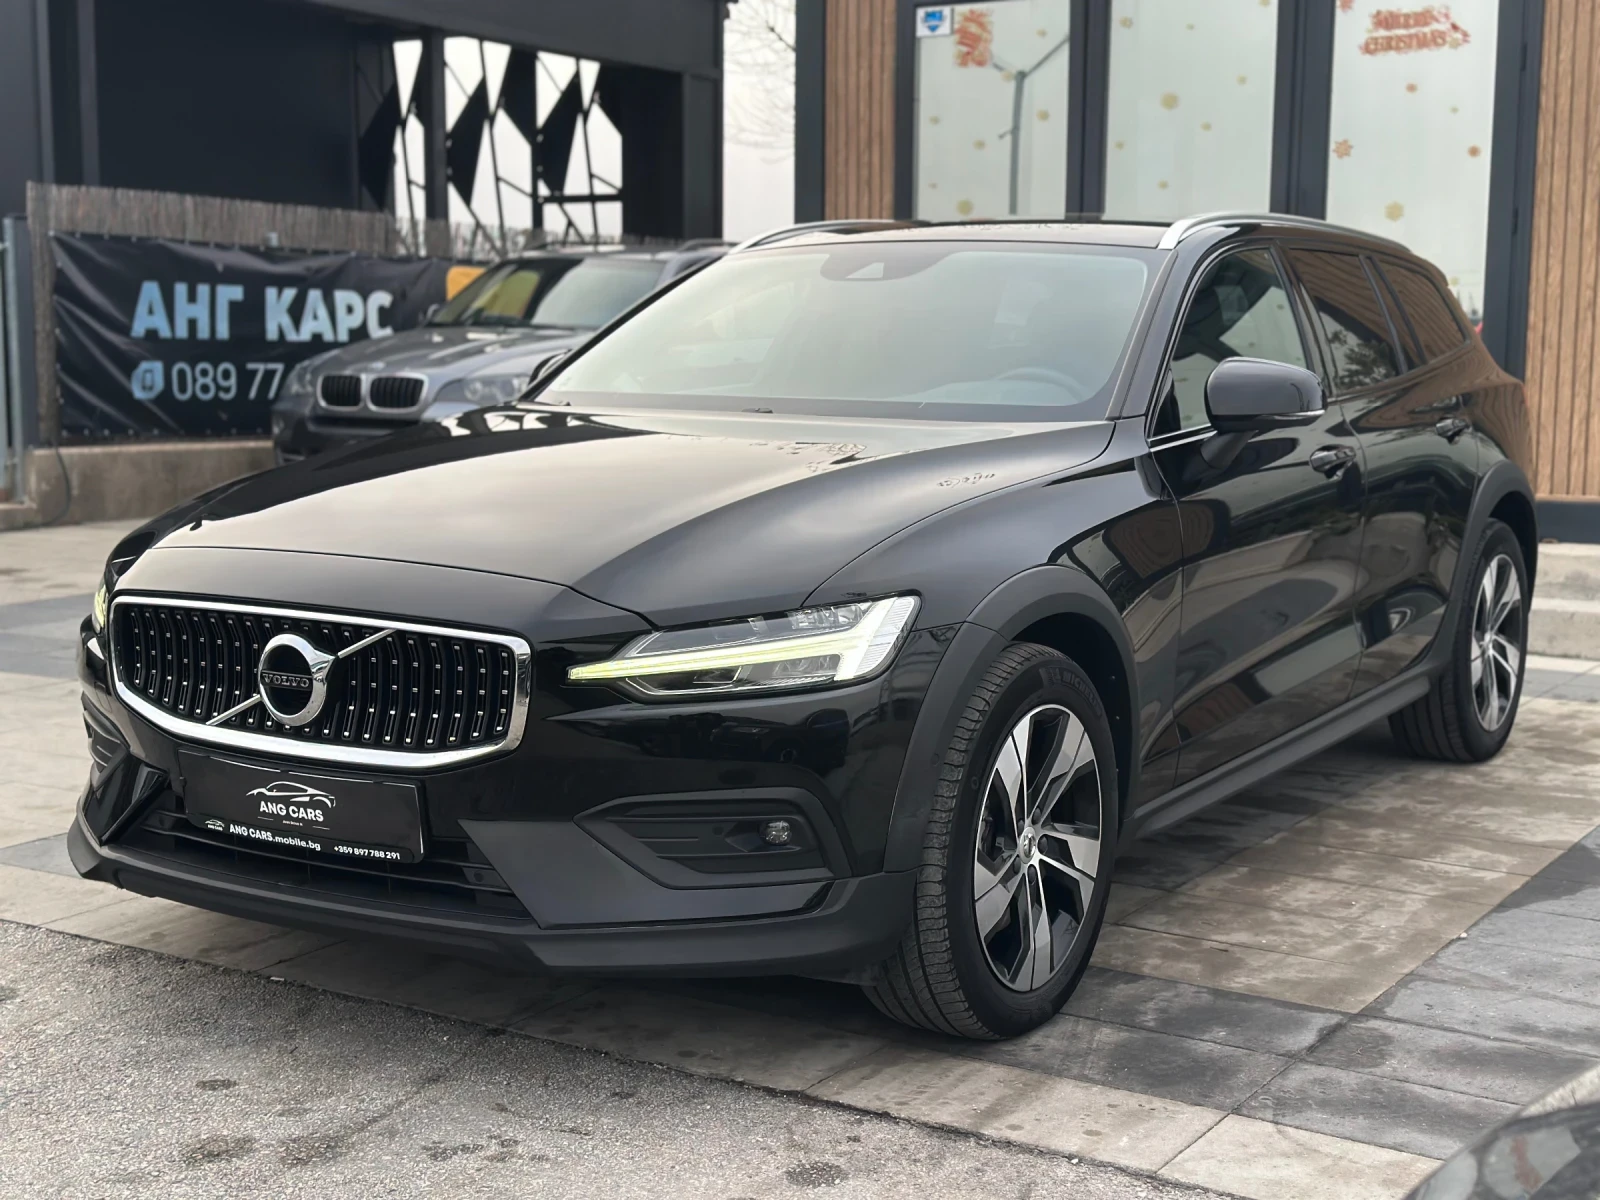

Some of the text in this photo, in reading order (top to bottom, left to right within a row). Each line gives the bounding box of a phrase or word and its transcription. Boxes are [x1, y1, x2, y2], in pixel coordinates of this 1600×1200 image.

[130, 280, 395, 343] АНГ КАРС
[171, 361, 285, 401] 089 77
[262, 674, 310, 687] VOLVO
[259, 801, 324, 822] ANG CARS
[229, 824, 321, 851] ANG CARS.mobile.bg
[334, 845, 401, 860] +359 897 788 291
